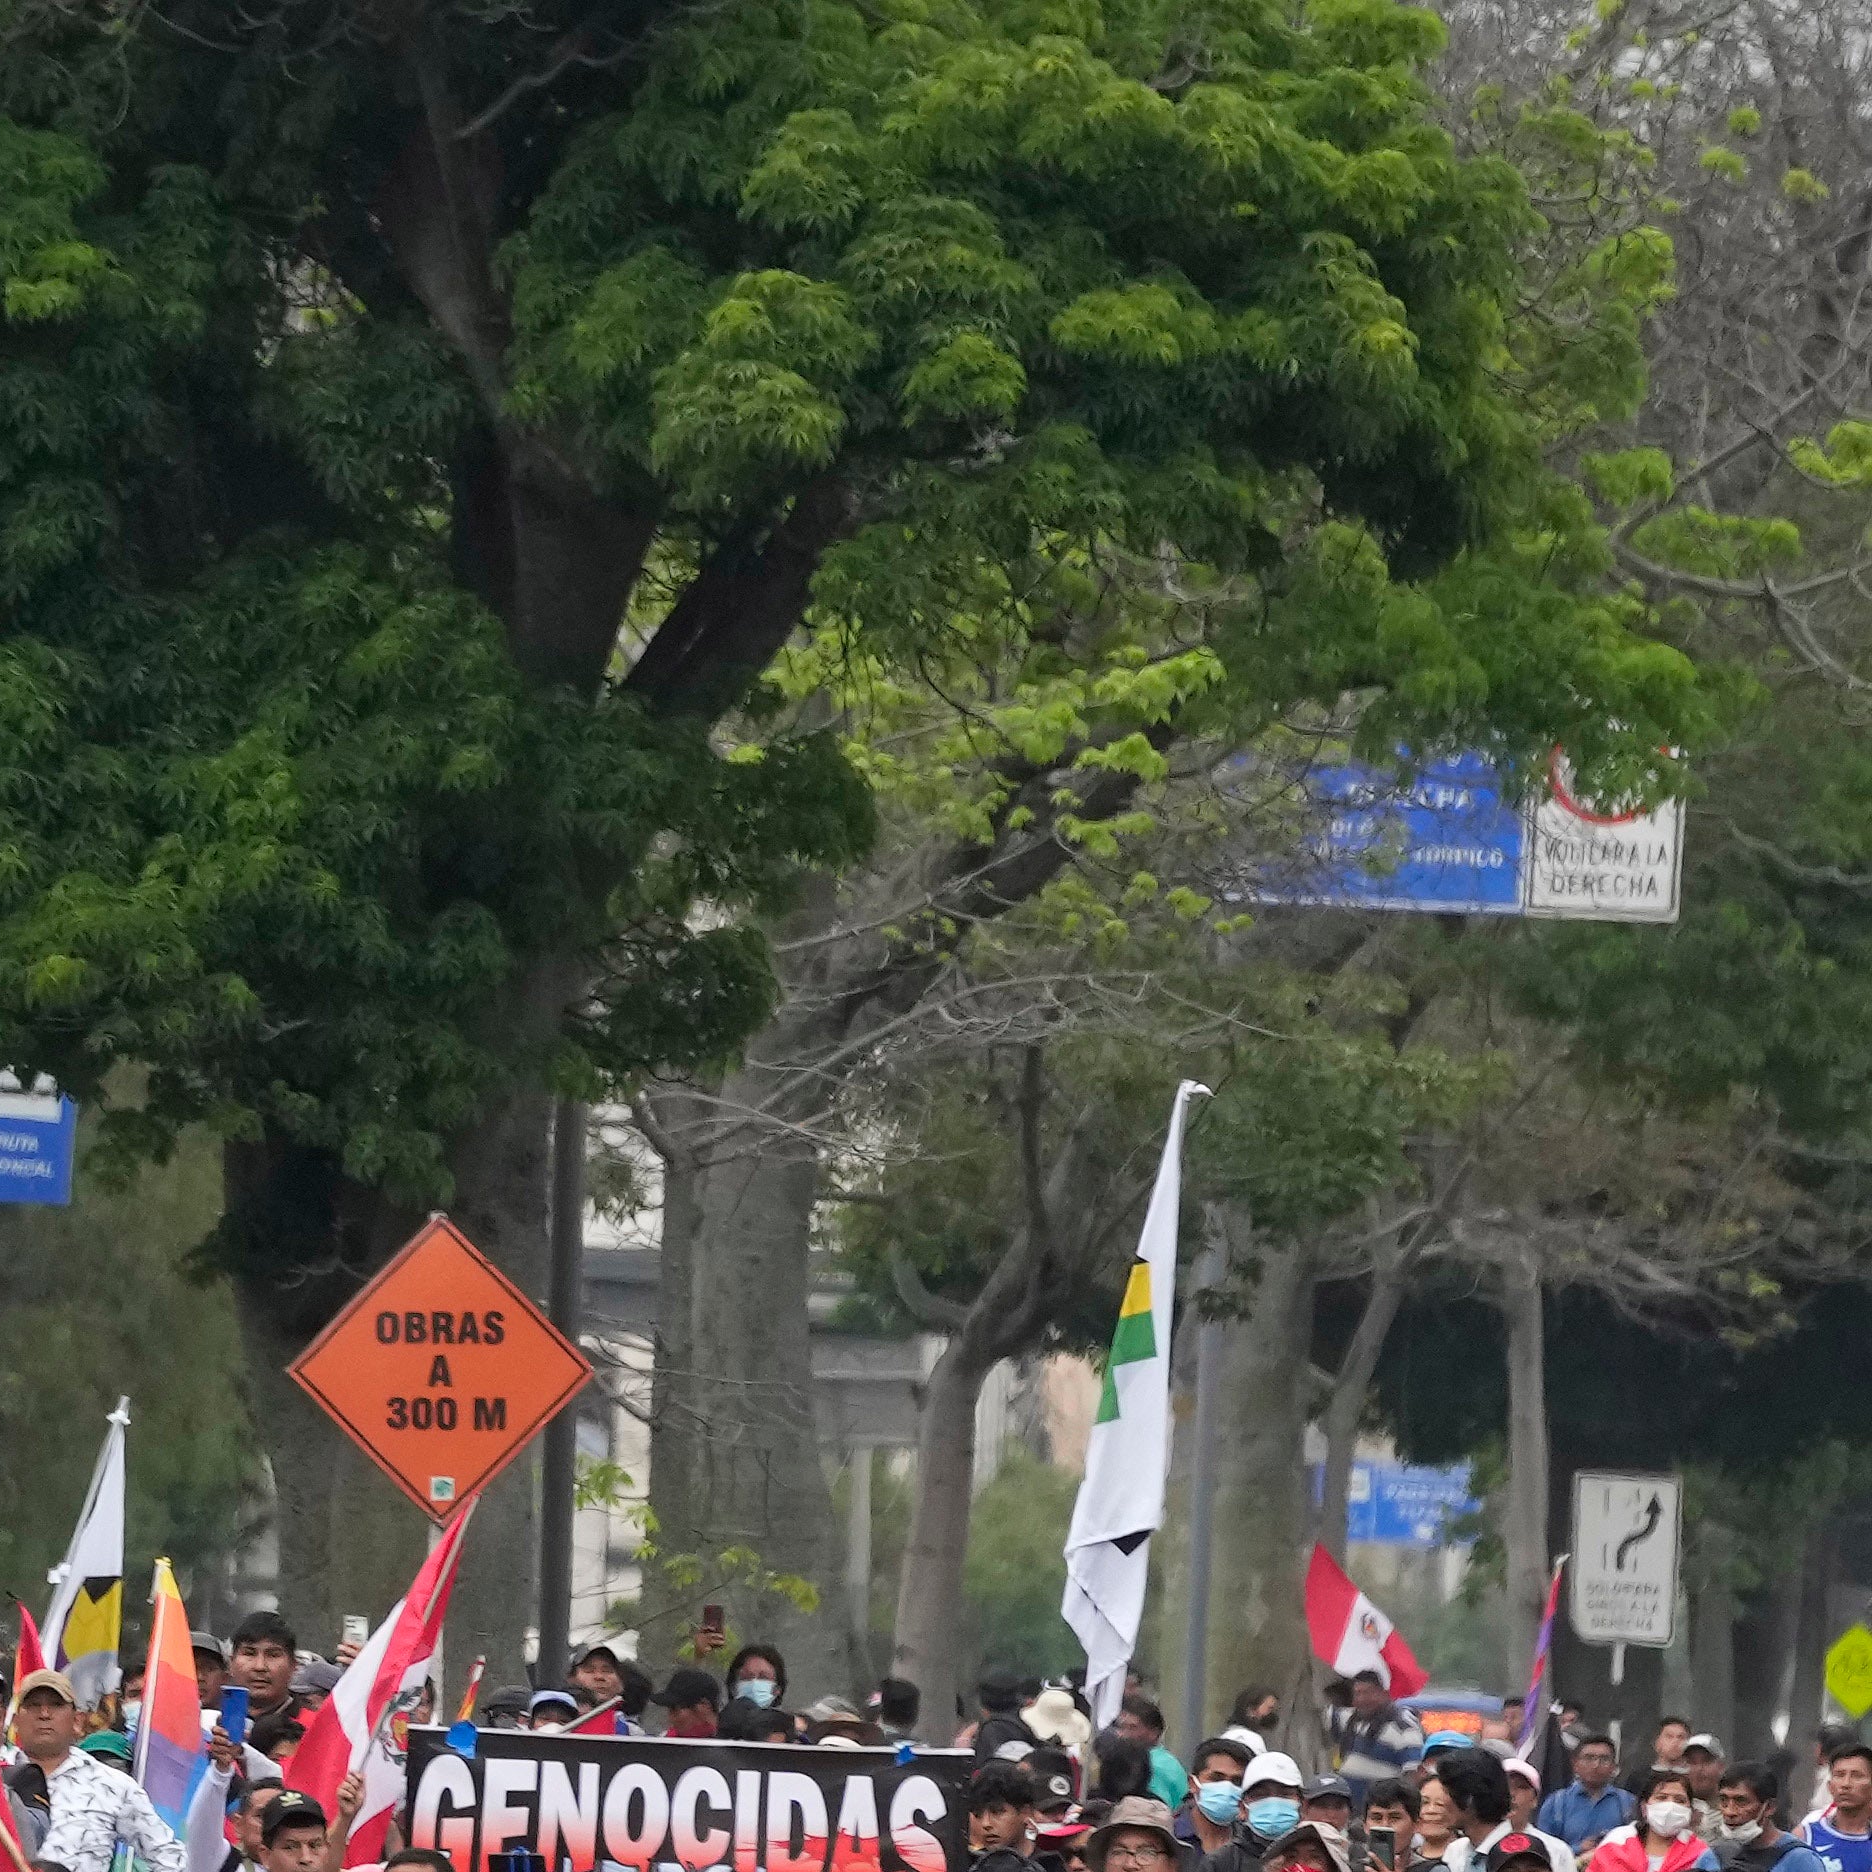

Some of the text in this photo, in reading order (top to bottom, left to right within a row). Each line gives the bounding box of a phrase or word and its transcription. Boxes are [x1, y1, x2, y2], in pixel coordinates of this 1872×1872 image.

[376, 1311, 505, 1344] OBRAS
[429, 1354, 452, 1387] A
[386, 1397, 506, 1430] 300 M
